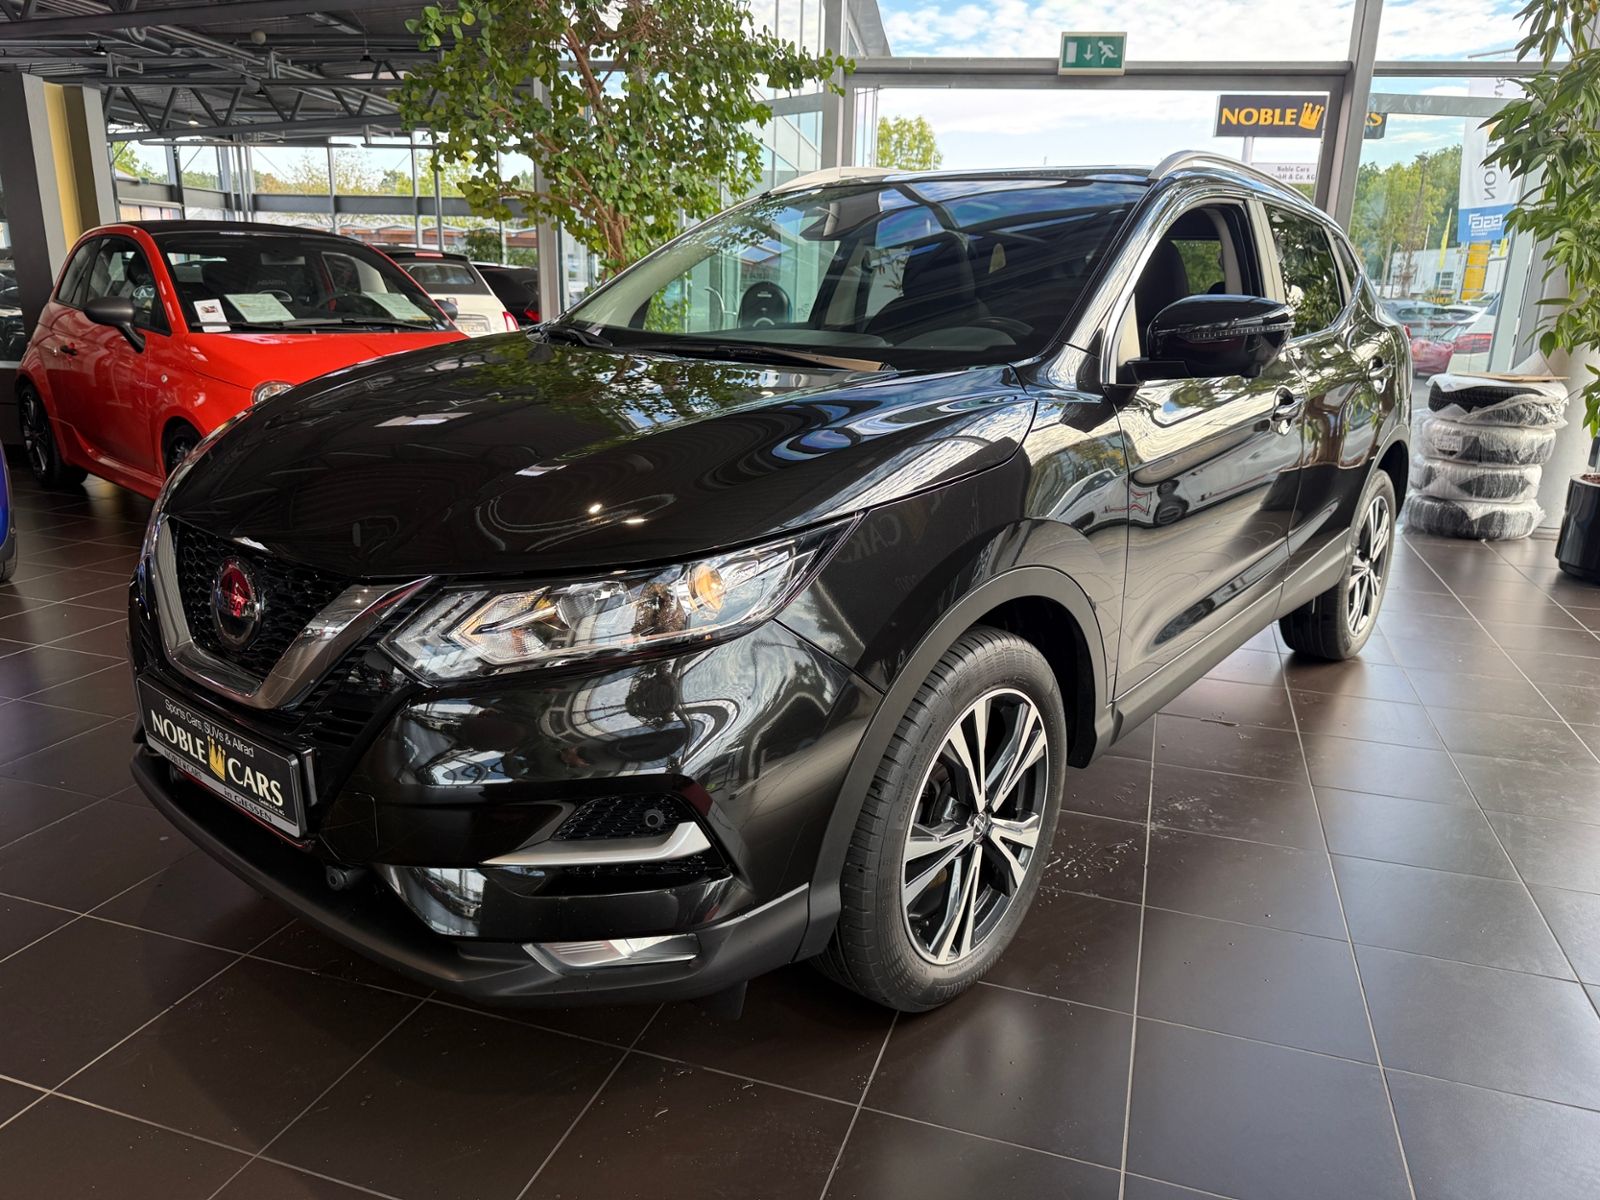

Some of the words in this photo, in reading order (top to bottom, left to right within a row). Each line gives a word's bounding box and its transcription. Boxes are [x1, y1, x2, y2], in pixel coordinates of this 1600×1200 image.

[1221, 107, 1298, 126] NOBLE
[204, 721, 225, 742] SUVs
[232, 736, 254, 758] Allrad
[151, 709, 208, 765] NOBLE
[227, 756, 284, 807] CARS
[234, 795, 273, 822] GIESSEN
